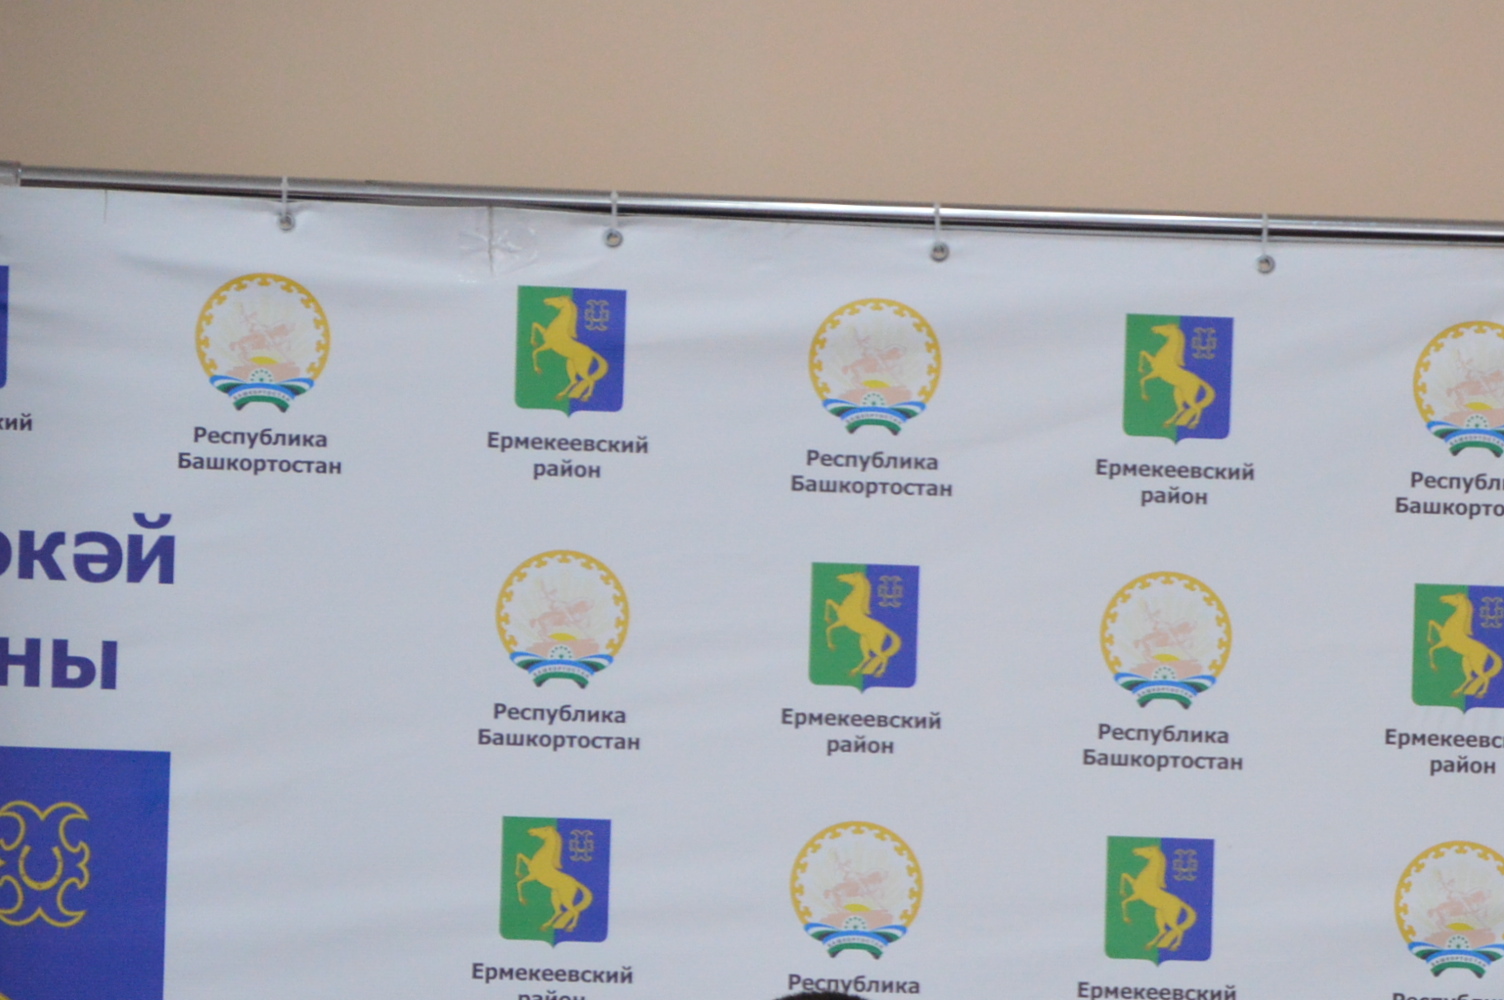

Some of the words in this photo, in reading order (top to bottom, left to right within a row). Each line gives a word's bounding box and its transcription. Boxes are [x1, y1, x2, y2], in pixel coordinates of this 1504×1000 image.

[193, 426, 328, 449] Республика
[487, 431, 648, 454] Ермекеевский
[178, 452, 342, 476] Башкортостан
[533, 459, 601, 481] район
[806, 449, 939, 472] Республика
[1095, 458, 1255, 481] Ермекеевский
[791, 474, 953, 498] Башкортостан
[1141, 486, 1208, 507] район
[0, 512, 175, 585] кәй
[493, 702, 626, 726] Республика
[781, 707, 941, 730] Ермекеевский
[478, 728, 640, 752] Башкортостан
[827, 735, 894, 757] район
[1098, 723, 1229, 746] Республика
[1083, 748, 1243, 772] Башкортостан
[1430, 755, 1496, 777] район
[472, 962, 633, 984] Ермекеевский
[788, 973, 920, 994] Республика
